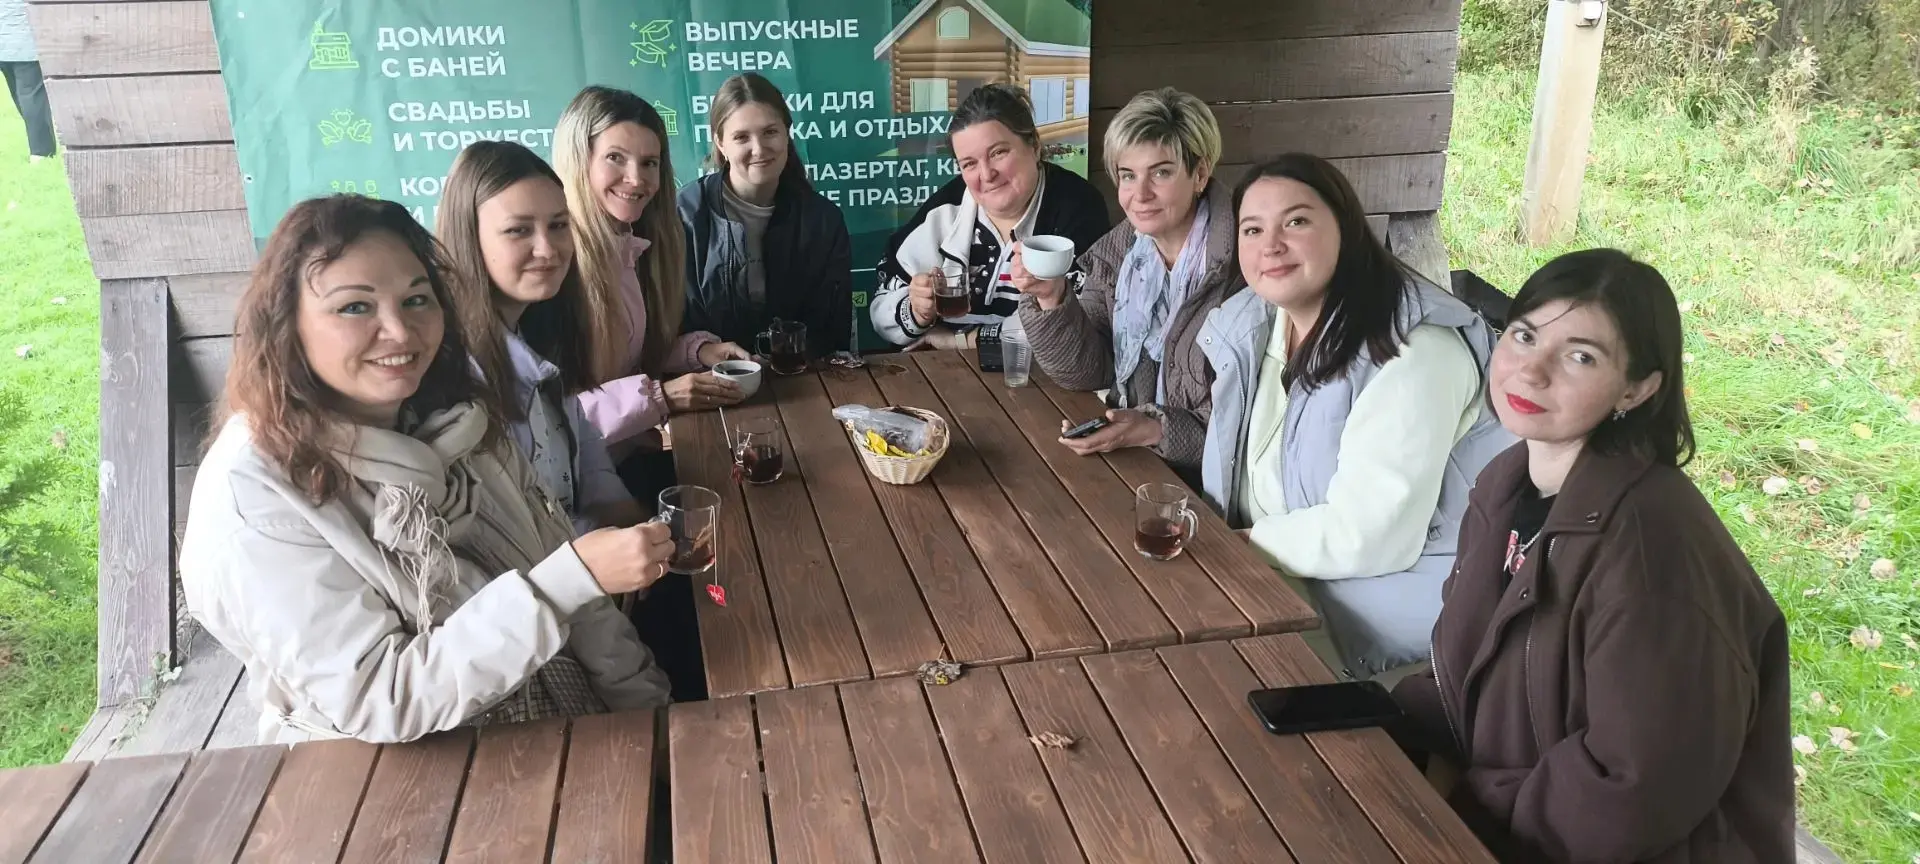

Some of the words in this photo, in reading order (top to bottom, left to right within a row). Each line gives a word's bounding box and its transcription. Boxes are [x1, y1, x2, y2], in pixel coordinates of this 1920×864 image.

[377, 25, 506, 51] ДОМИКИ
[685, 18, 859, 42] ВЫПУСКНЫЕ
[381, 57, 401, 78] С
[408, 51, 506, 78] БАНЕЙ
[688, 50, 791, 72] ВЕЧЕРА
[388, 99, 530, 125] СВАДЬБЫ
[820, 90, 874, 113] ДЛЯ
[393, 132, 414, 152] И
[420, 128, 554, 152] ТОРЖЕСТ
[830, 120, 847, 138] И
